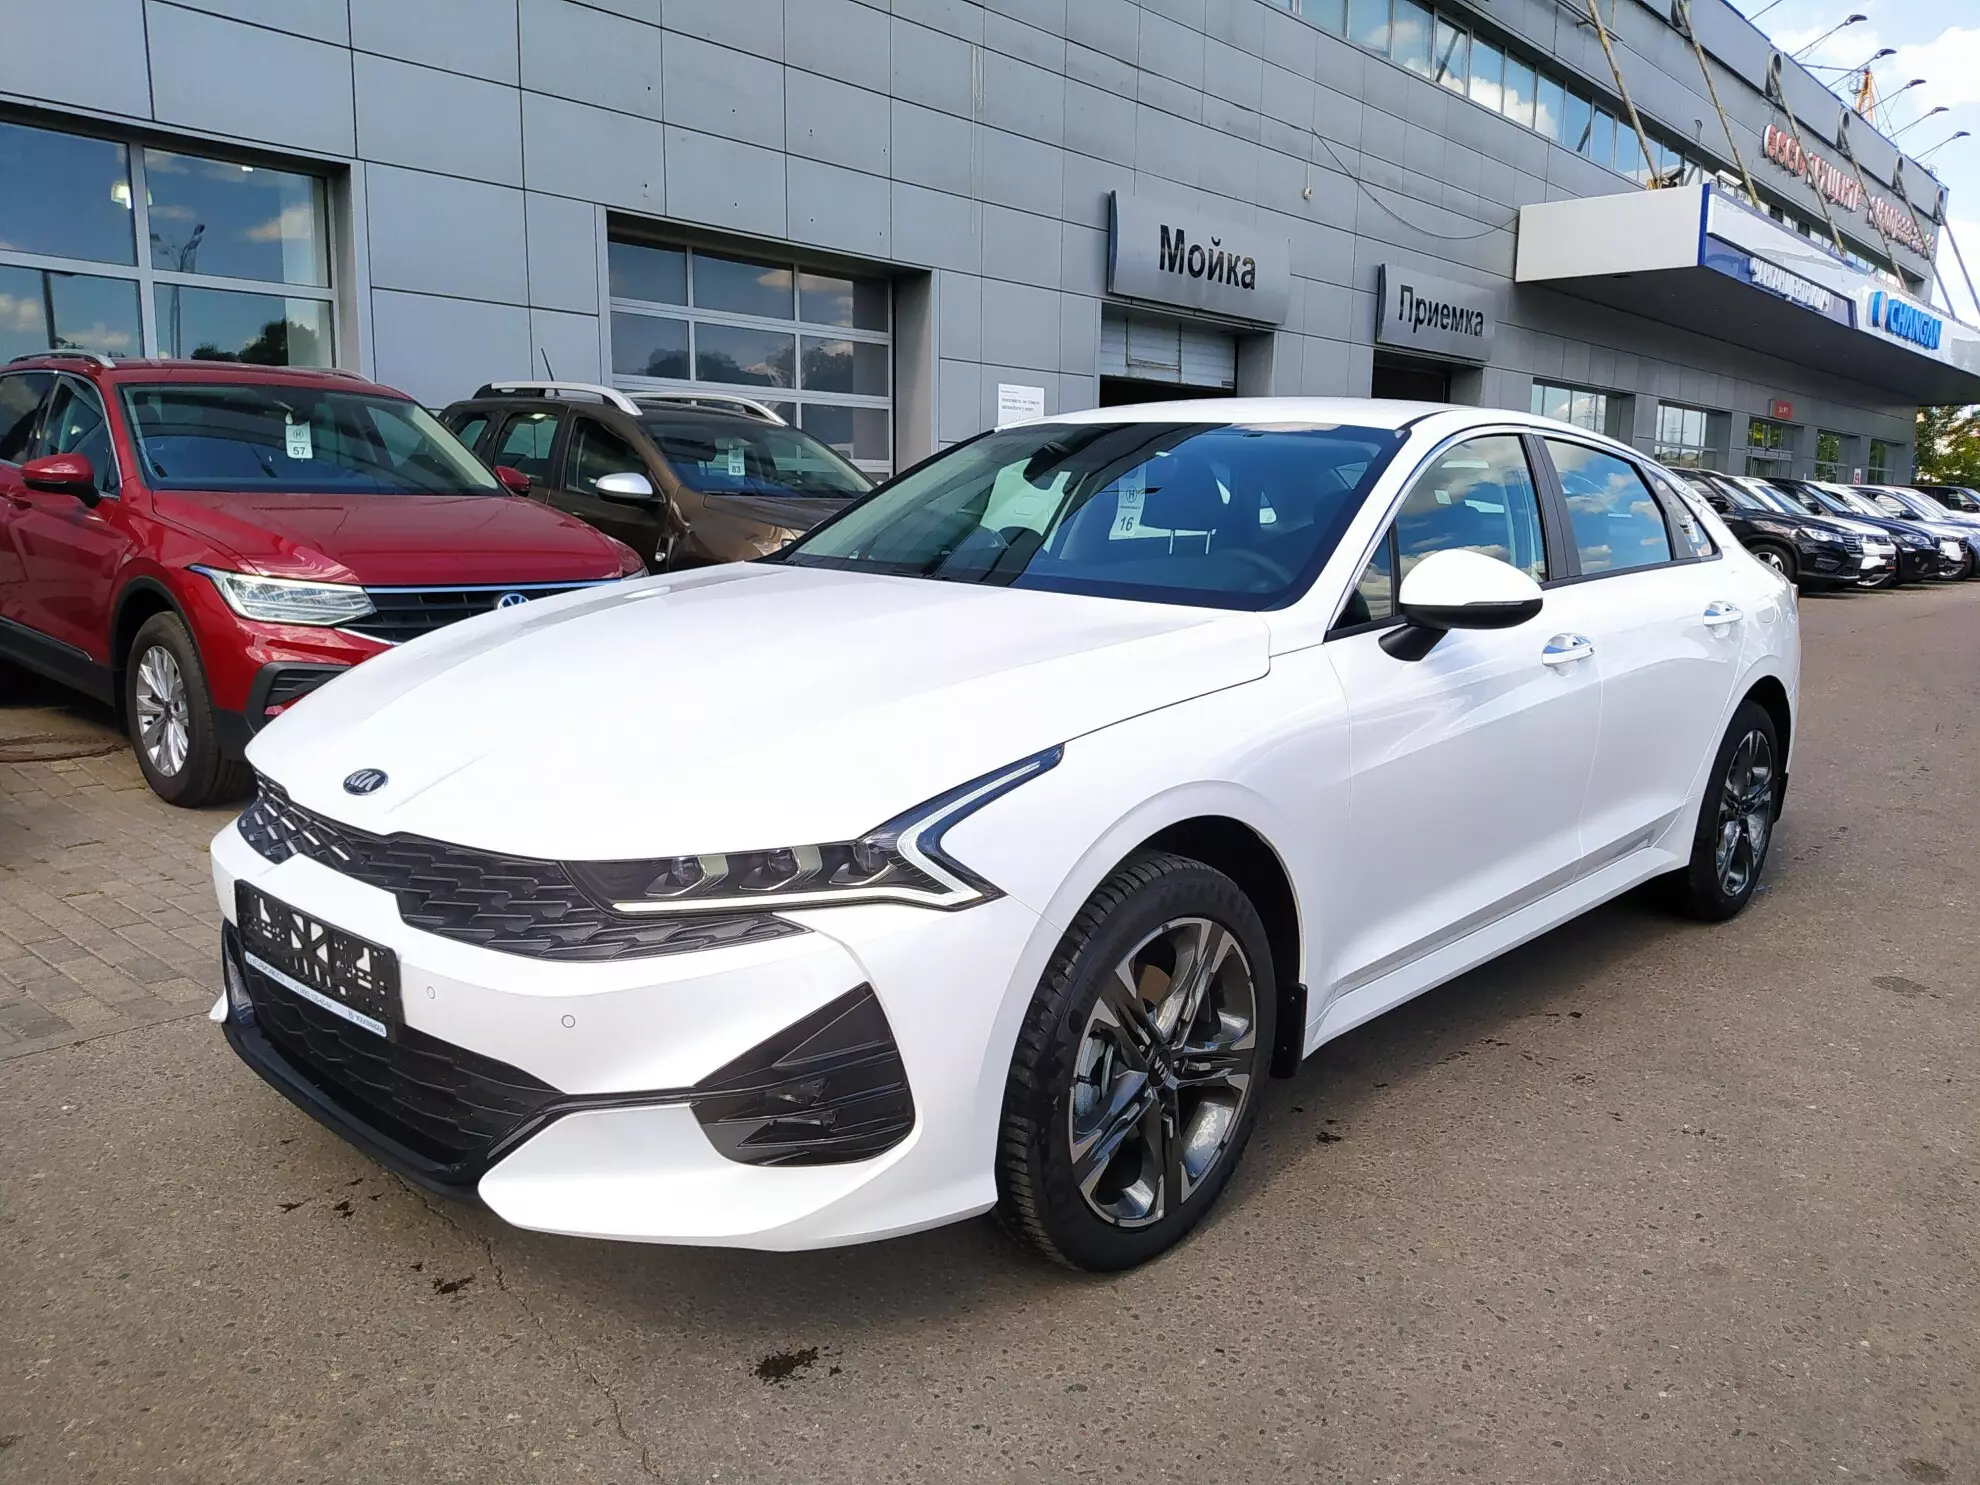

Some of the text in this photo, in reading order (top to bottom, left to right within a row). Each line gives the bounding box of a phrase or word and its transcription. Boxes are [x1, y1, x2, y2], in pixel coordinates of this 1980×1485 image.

[1159, 223, 1256, 290] Мойка
[1399, 284, 1484, 337] Приемка
[1887, 299, 1942, 349] CHANGAN
[292, 446, 306, 456] 57
[1120, 516, 1134, 531] 16
